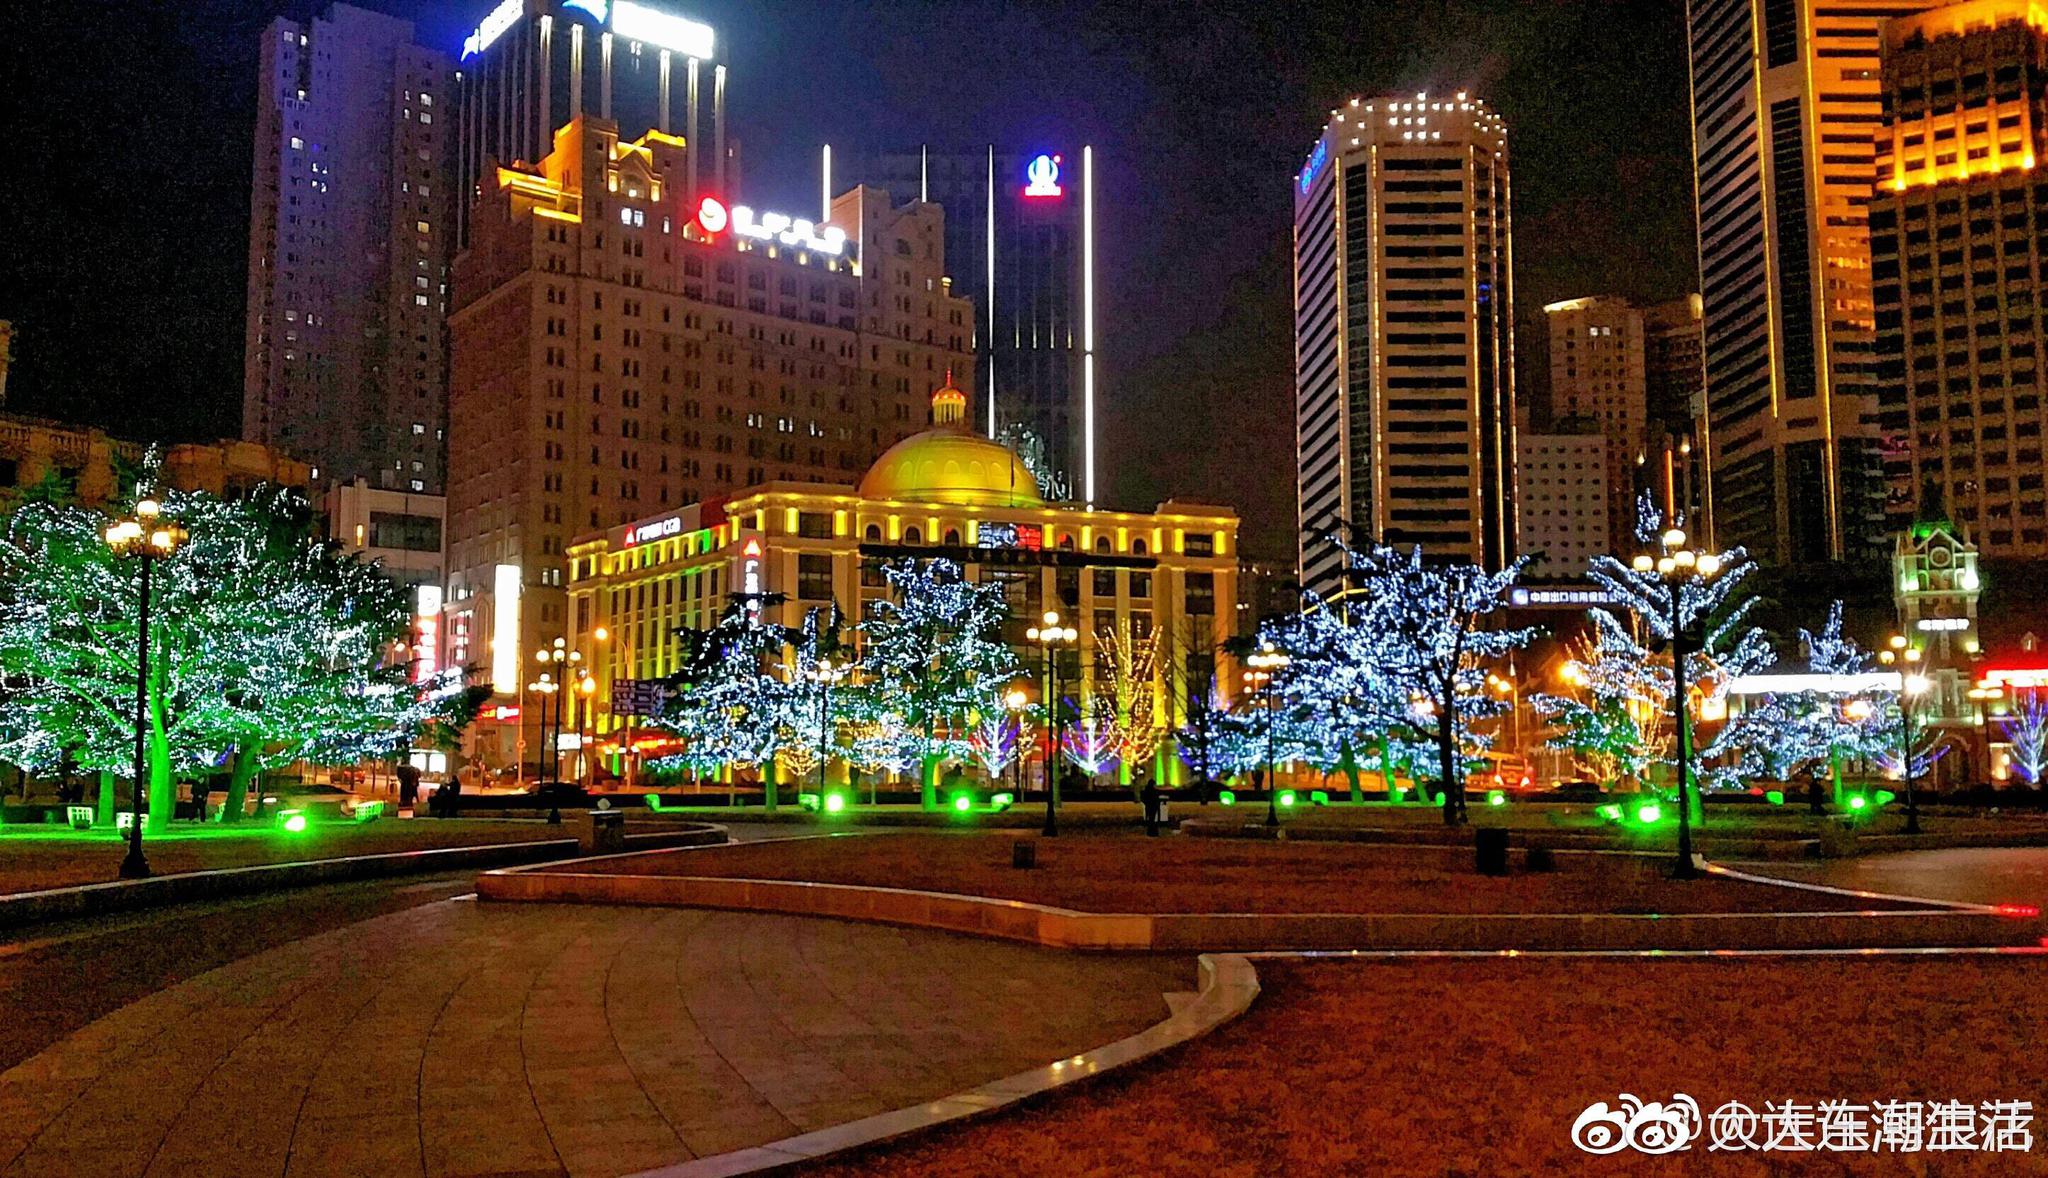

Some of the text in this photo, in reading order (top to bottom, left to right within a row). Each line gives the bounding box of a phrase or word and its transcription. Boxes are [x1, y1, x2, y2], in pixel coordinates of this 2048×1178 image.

[1530, 591, 1625, 603] 中国出口信用保险
